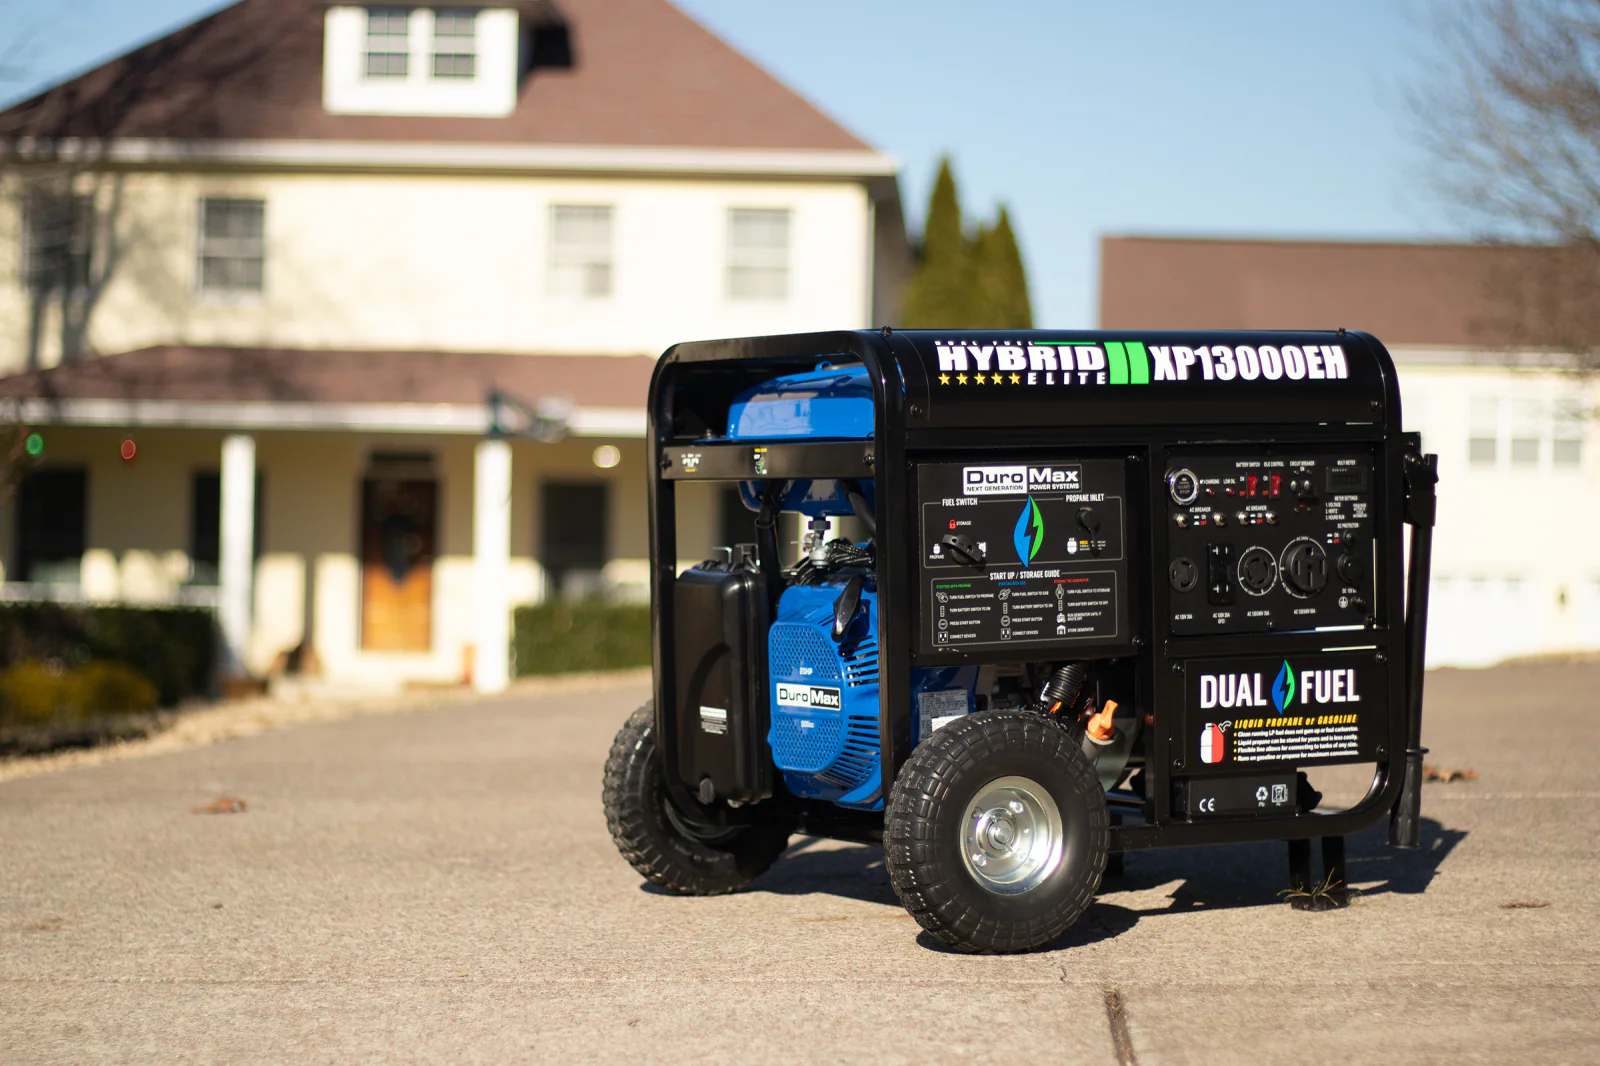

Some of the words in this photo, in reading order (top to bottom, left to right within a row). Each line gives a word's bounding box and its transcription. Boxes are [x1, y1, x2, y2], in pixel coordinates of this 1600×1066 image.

[936, 346, 1105, 371] HYBRID
[1149, 345, 1348, 381] XP13000EH
[1027, 372, 1106, 385] ELITE
[966, 468, 1079, 485] DuroMax
[1066, 494, 1089, 502] PROPANE
[990, 572, 1006, 580] START
[1007, 572, 1014, 580] UP
[1020, 570, 1043, 579] STORAGE
[1044, 570, 1060, 578] GUIDE
[800, 667, 813, 675] 20HP
[1200, 673, 1267, 708] DUAL
[1301, 669, 1360, 704] FUEL
[780, 688, 839, 706] DuroMax
[1234, 719, 1263, 729] LIQUID
[1266, 717, 1303, 727] PROPANE
[1318, 714, 1356, 725] GASOLINE
[1199, 797, 1215, 812] CE
